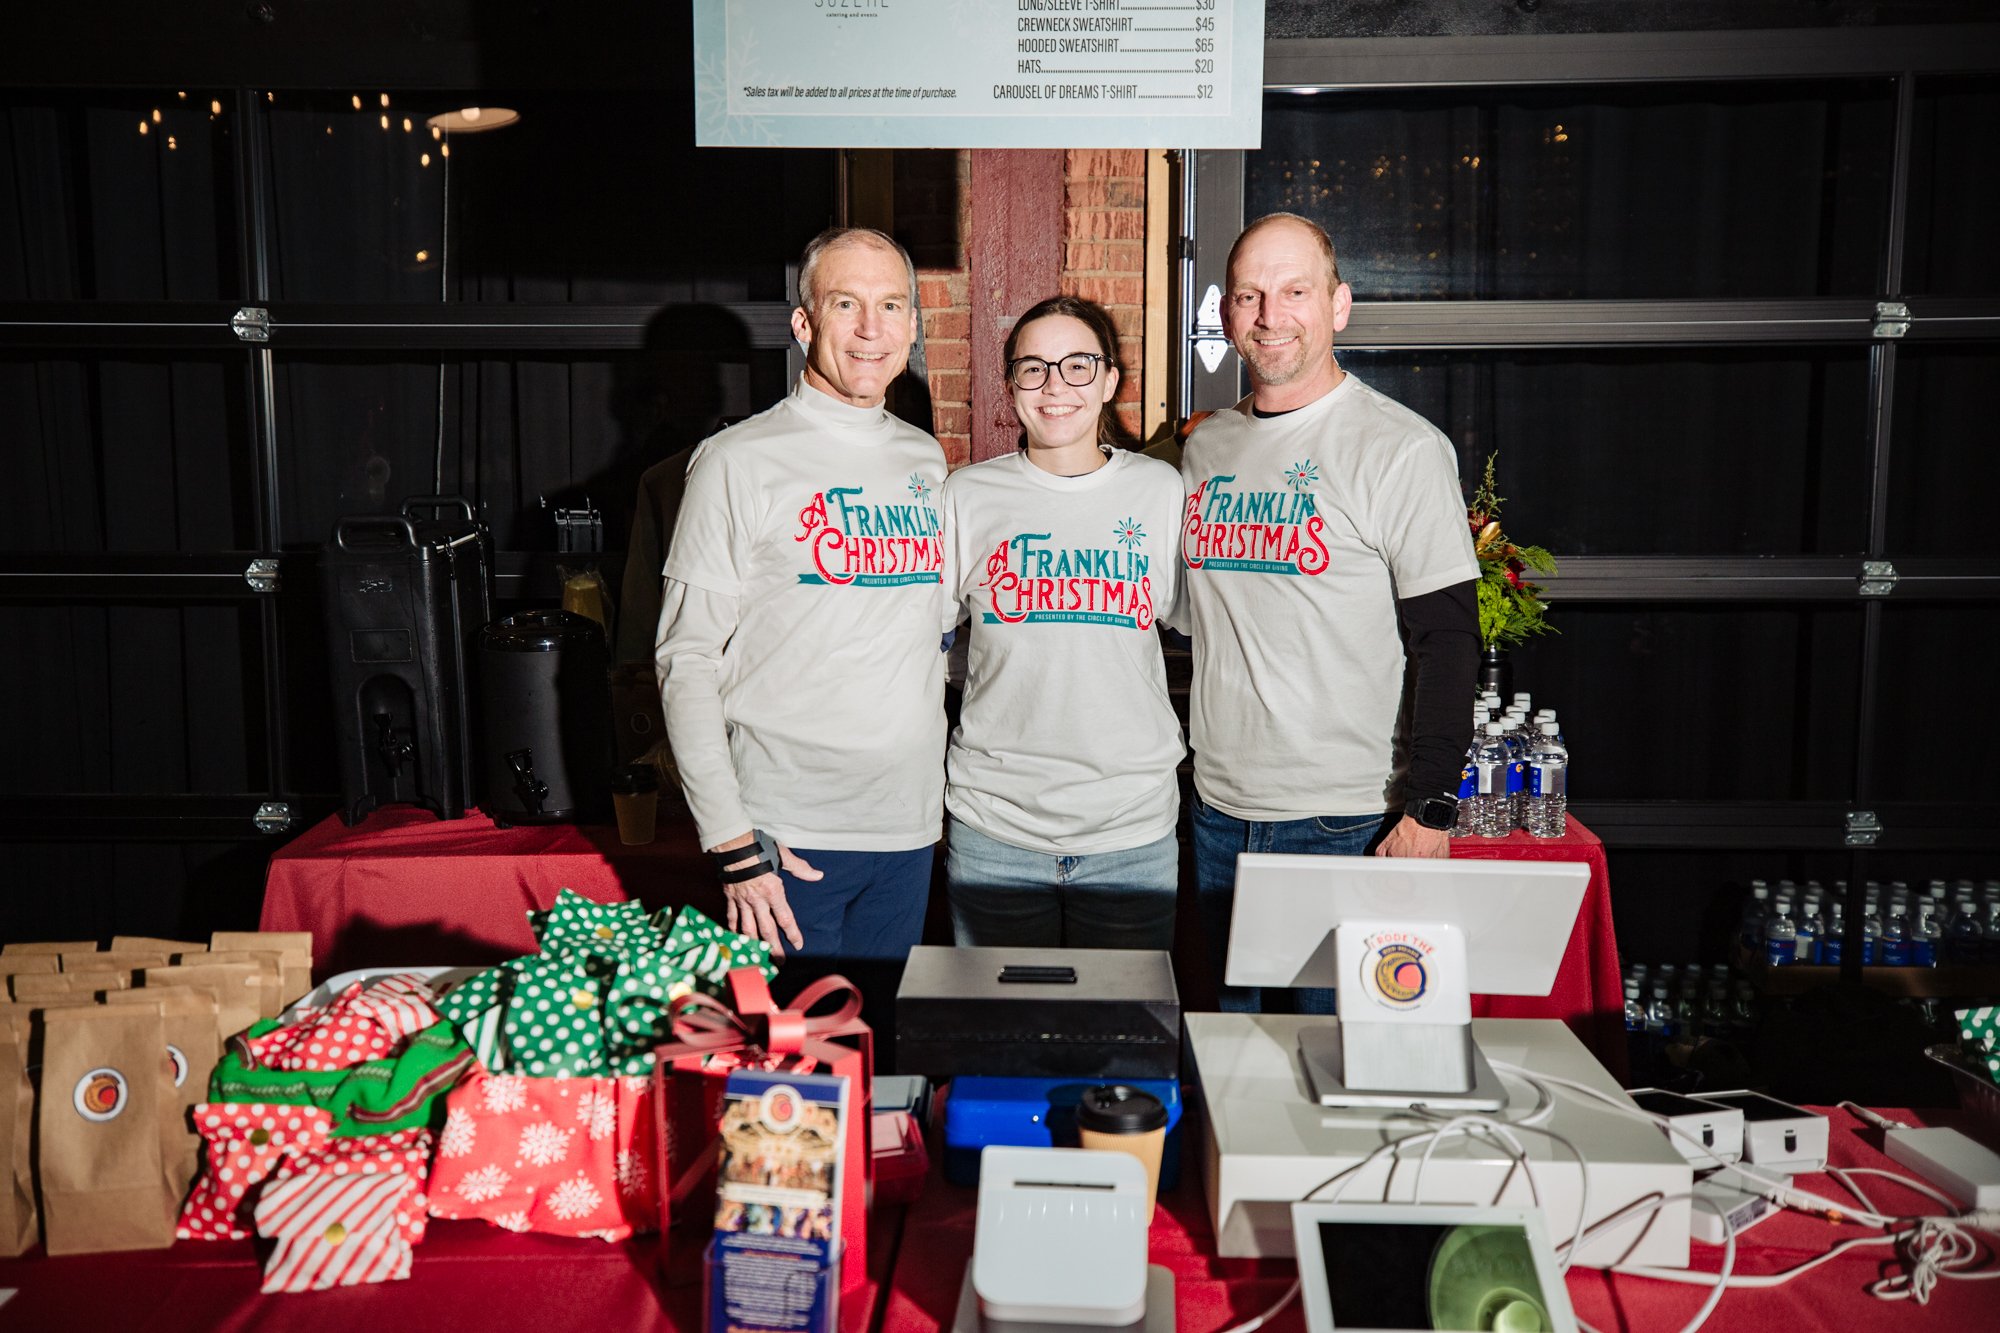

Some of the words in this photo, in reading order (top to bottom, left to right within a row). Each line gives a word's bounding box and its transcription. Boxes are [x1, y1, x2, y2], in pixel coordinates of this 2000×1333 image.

[1018, 18, 1071, 31] CREWNECK
[1073, 18, 1133, 31] SWEATSHIRT
[1195, 17, 1215, 31] $45
[1018, 39, 1057, 52] HOODED
[1059, 38, 1119, 52] SWEATSHIRT
[1194, 38, 1214, 52] $65
[1018, 60, 1041, 73] HATS
[1194, 59, 1214, 73] $20
[768, 88, 778, 97] tax
[780, 87, 793, 97] will
[795, 87, 804, 97] be
[805, 87, 828, 97] added
[830, 88, 837, 97] to
[839, 87, 847, 97] all
[849, 87, 871, 99] prices
[873, 88, 881, 98] at
[882, 87, 893, 98] the
[895, 87, 911, 98] time
[913, 87, 921, 98] of
[921, 87, 956, 99] purchase.
[994, 85, 1042, 99] CAROUSEL
[1044, 85, 1056, 99] OF
[1059, 85, 1099, 99] DREAMS
[1102, 85, 1138, 99] T-SHIRT
[1197, 85, 1213, 99] $12
[794, 492, 828, 542] A
[826, 486, 939, 537] FRANKLIN
[1203, 474, 1316, 525] FRANKLIN
[979, 540, 1009, 586] A
[1011, 533, 1148, 583] FRANKLIN
[1183, 514, 1329, 575] CHRISTMAS
[992, 572, 1153, 630] CHRISTMAS
